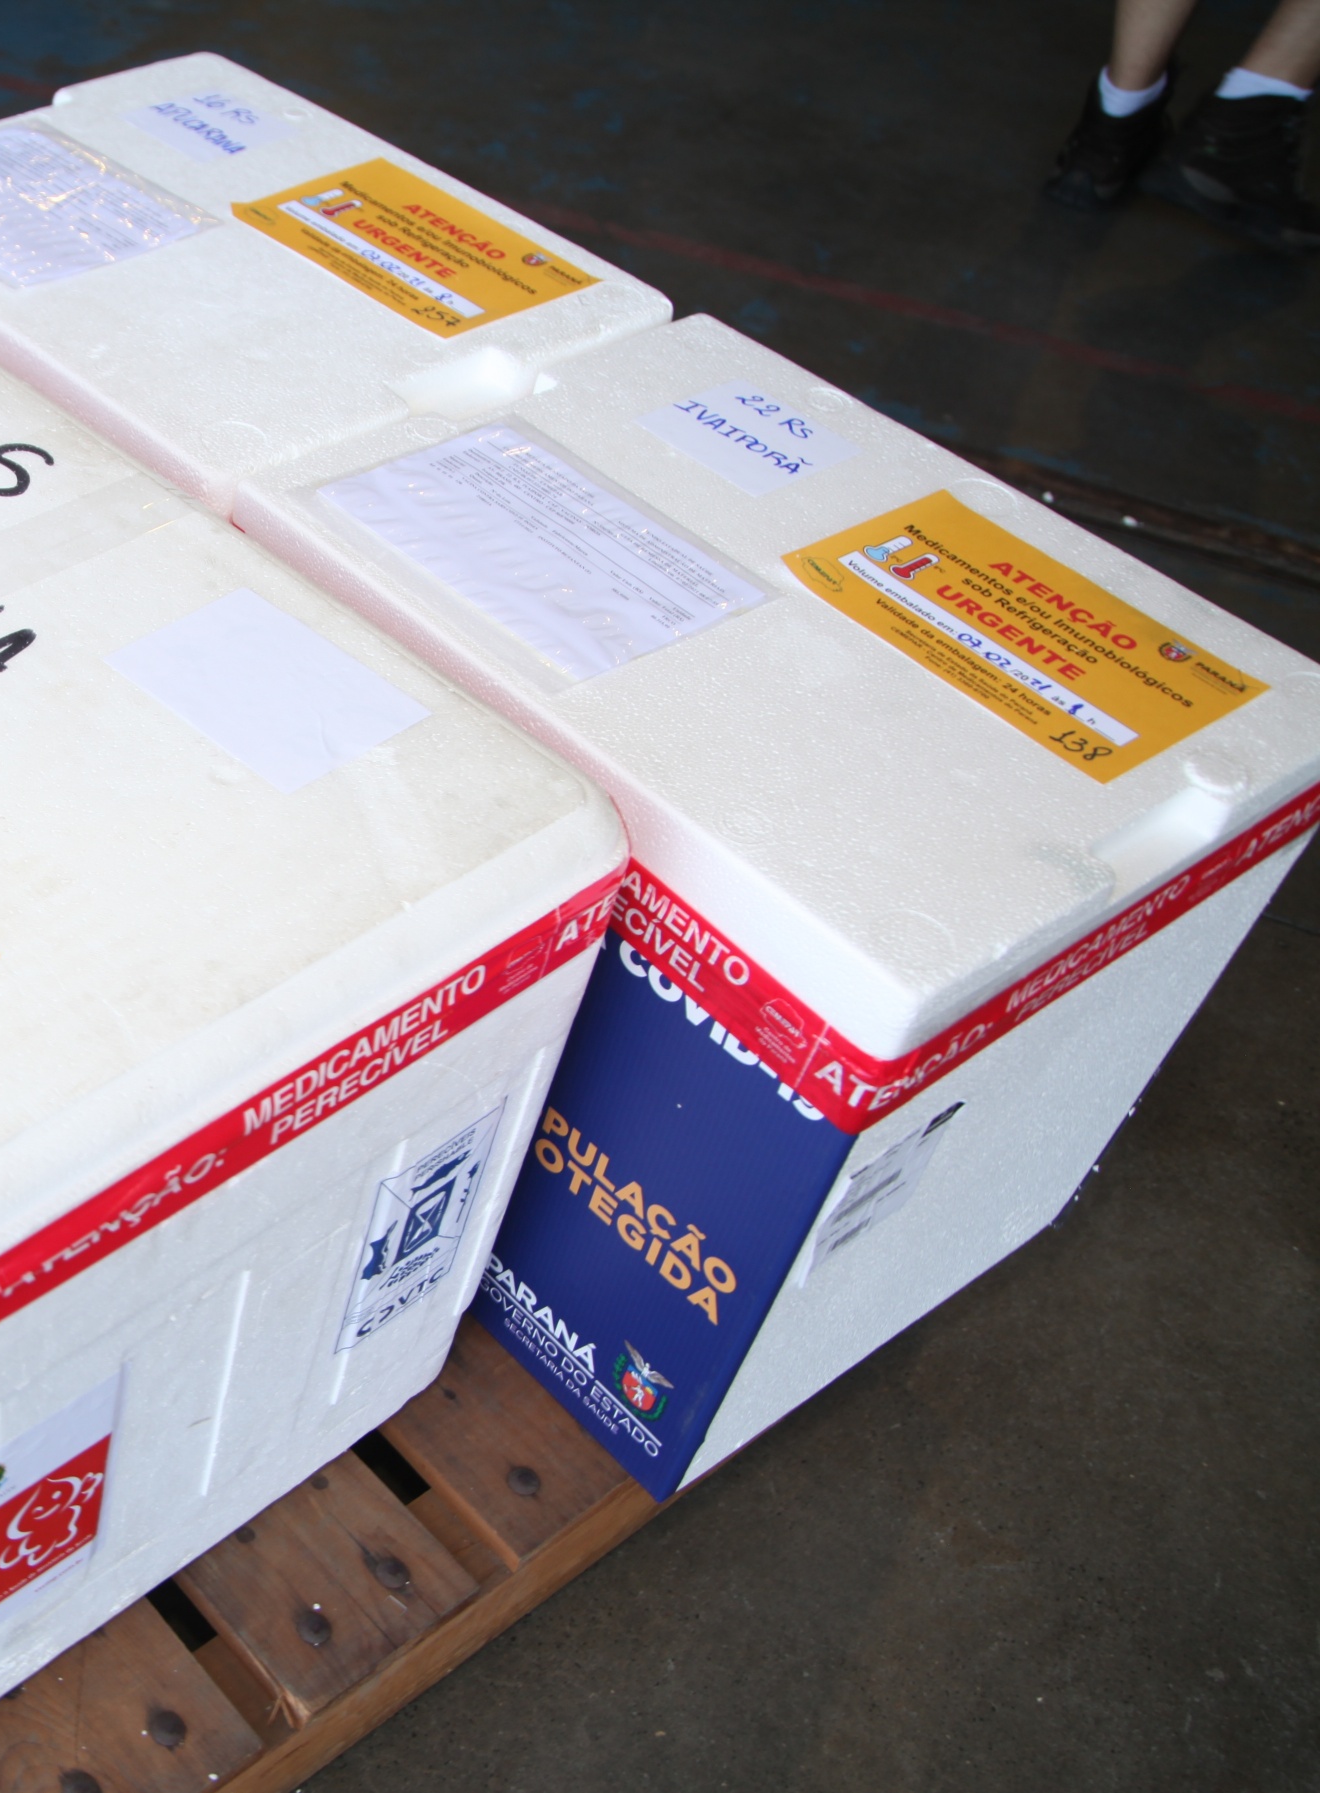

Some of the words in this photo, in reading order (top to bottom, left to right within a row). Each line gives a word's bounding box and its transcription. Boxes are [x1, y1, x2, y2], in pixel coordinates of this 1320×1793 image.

[340, 180, 416, 227] Medicamentos
[441, 239, 537, 295] Imunobiológicos
[352, 218, 456, 278] URGENTE
[376, 214, 399, 227] sob
[398, 226, 470, 268] Refrigeração
[402, 204, 506, 260] ATENÇÃO
[673, 399, 815, 476] IVAIPORÃ
[733, 394, 781, 419] 22
[778, 417, 815, 443] RS
[847, 559, 884, 588] Volume
[884, 587, 936, 621] embalado
[936, 620, 958, 635] em:
[1048, 692, 1071, 708] às
[1083, 715, 1100, 727] h
[875, 597, 920, 629] Validade
[916, 626, 939, 641] da
[935, 638, 1001, 683] embalagem:
[1001, 682, 1019, 694] 24
[1017, 692, 1052, 716] horas
[903, 523, 1014, 596] Medicamentos
[1015, 596, 1052, 620] e/ou
[1053, 618, 1194, 708] Imunobiológicos
[936, 584, 1086, 681] URGENTE
[961, 577, 993, 598] sob
[993, 596, 1098, 664] Refrigeração
[988, 562, 1137, 650] ATENÇÃO
[1045, 721, 1117, 768] 138
[1005, 874, 1191, 1013] MEDICAMENTO
[1015, 921, 1150, 1022] PERECÍVEL
[241, 964, 487, 1138] MEDICAMENTO
[269, 1020, 451, 1147] PERECÍVEL
[485, 1251, 597, 1374] PARANÁ
[480, 1276, 558, 1357] GOVERNO
[561, 1355, 588, 1387] DO
[589, 1384, 659, 1458] ESTADO
[503, 1316, 565, 1382] SECRETARIA
[565, 1378, 582, 1399] DA
[582, 1395, 620, 1435] SAÚDE
